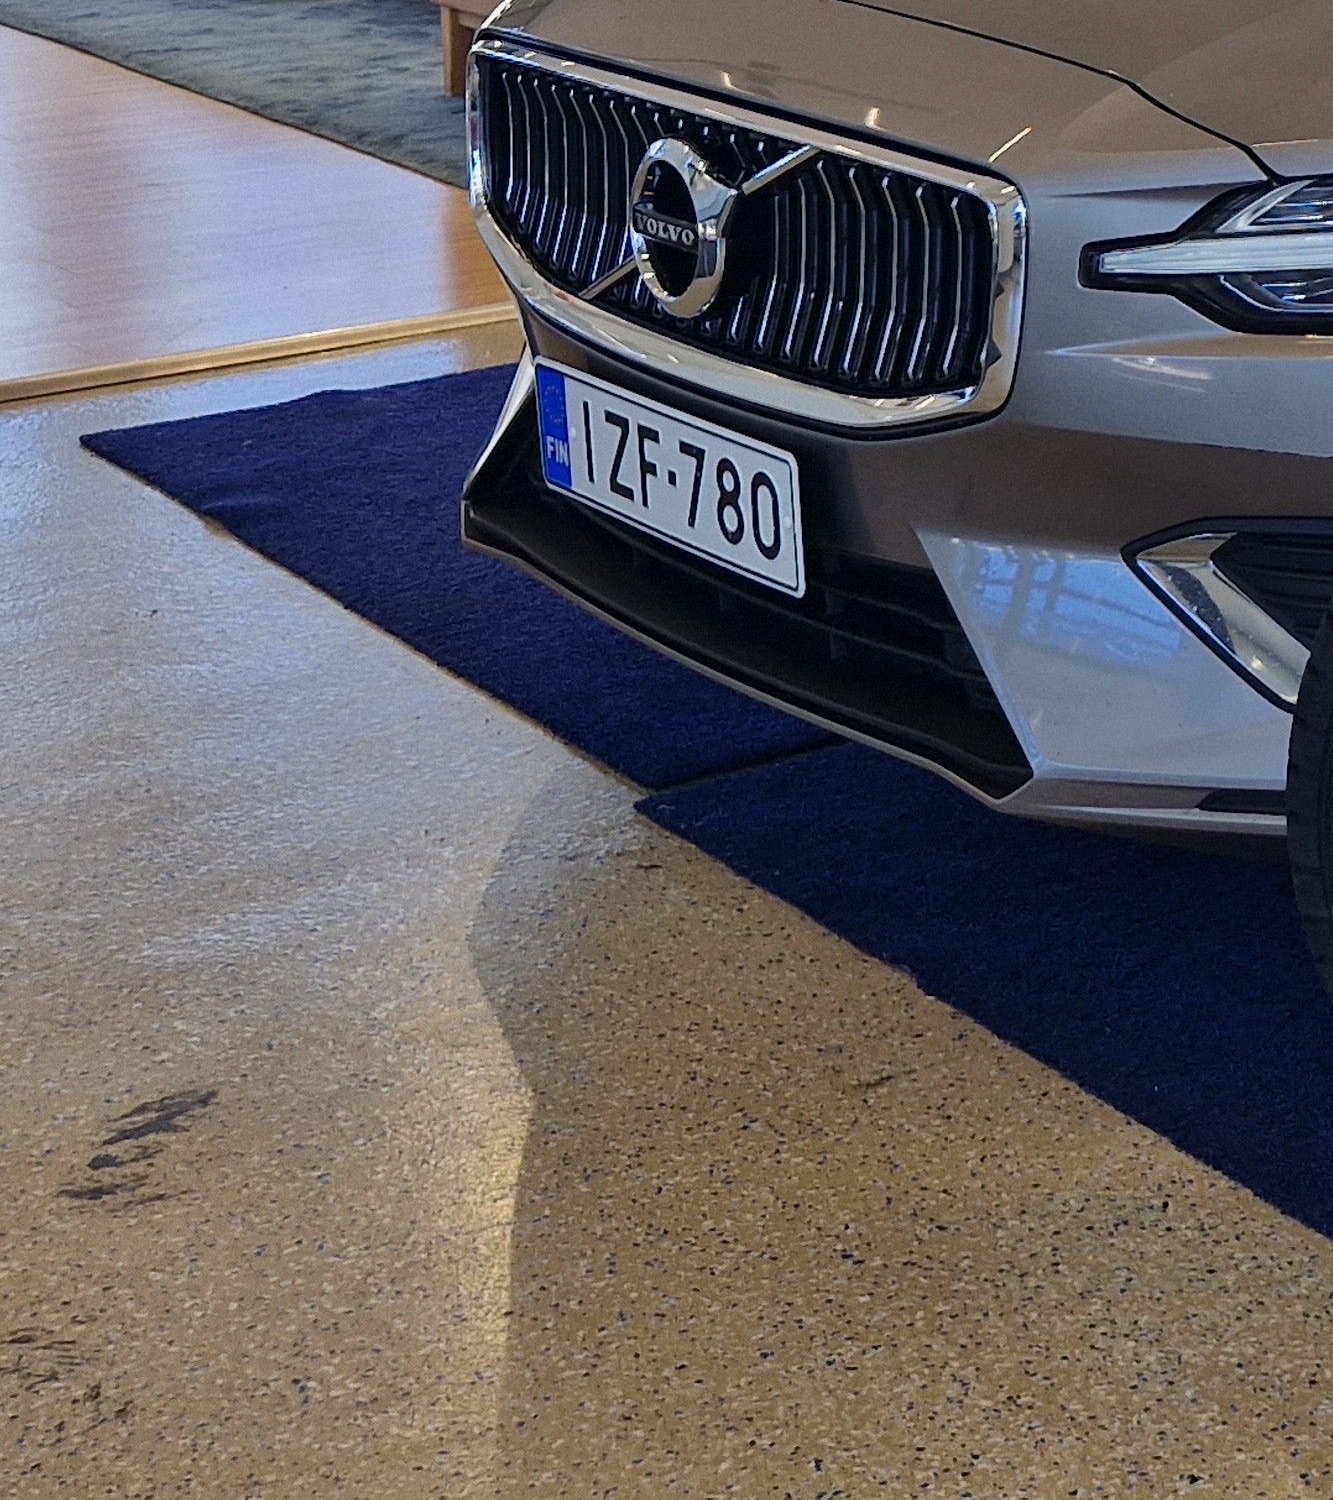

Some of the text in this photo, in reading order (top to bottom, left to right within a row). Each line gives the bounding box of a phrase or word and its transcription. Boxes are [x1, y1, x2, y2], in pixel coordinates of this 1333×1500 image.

[634, 211, 696, 246] VOLVO
[545, 434, 571, 468] FIN
[582, 400, 782, 561] IZF-780
